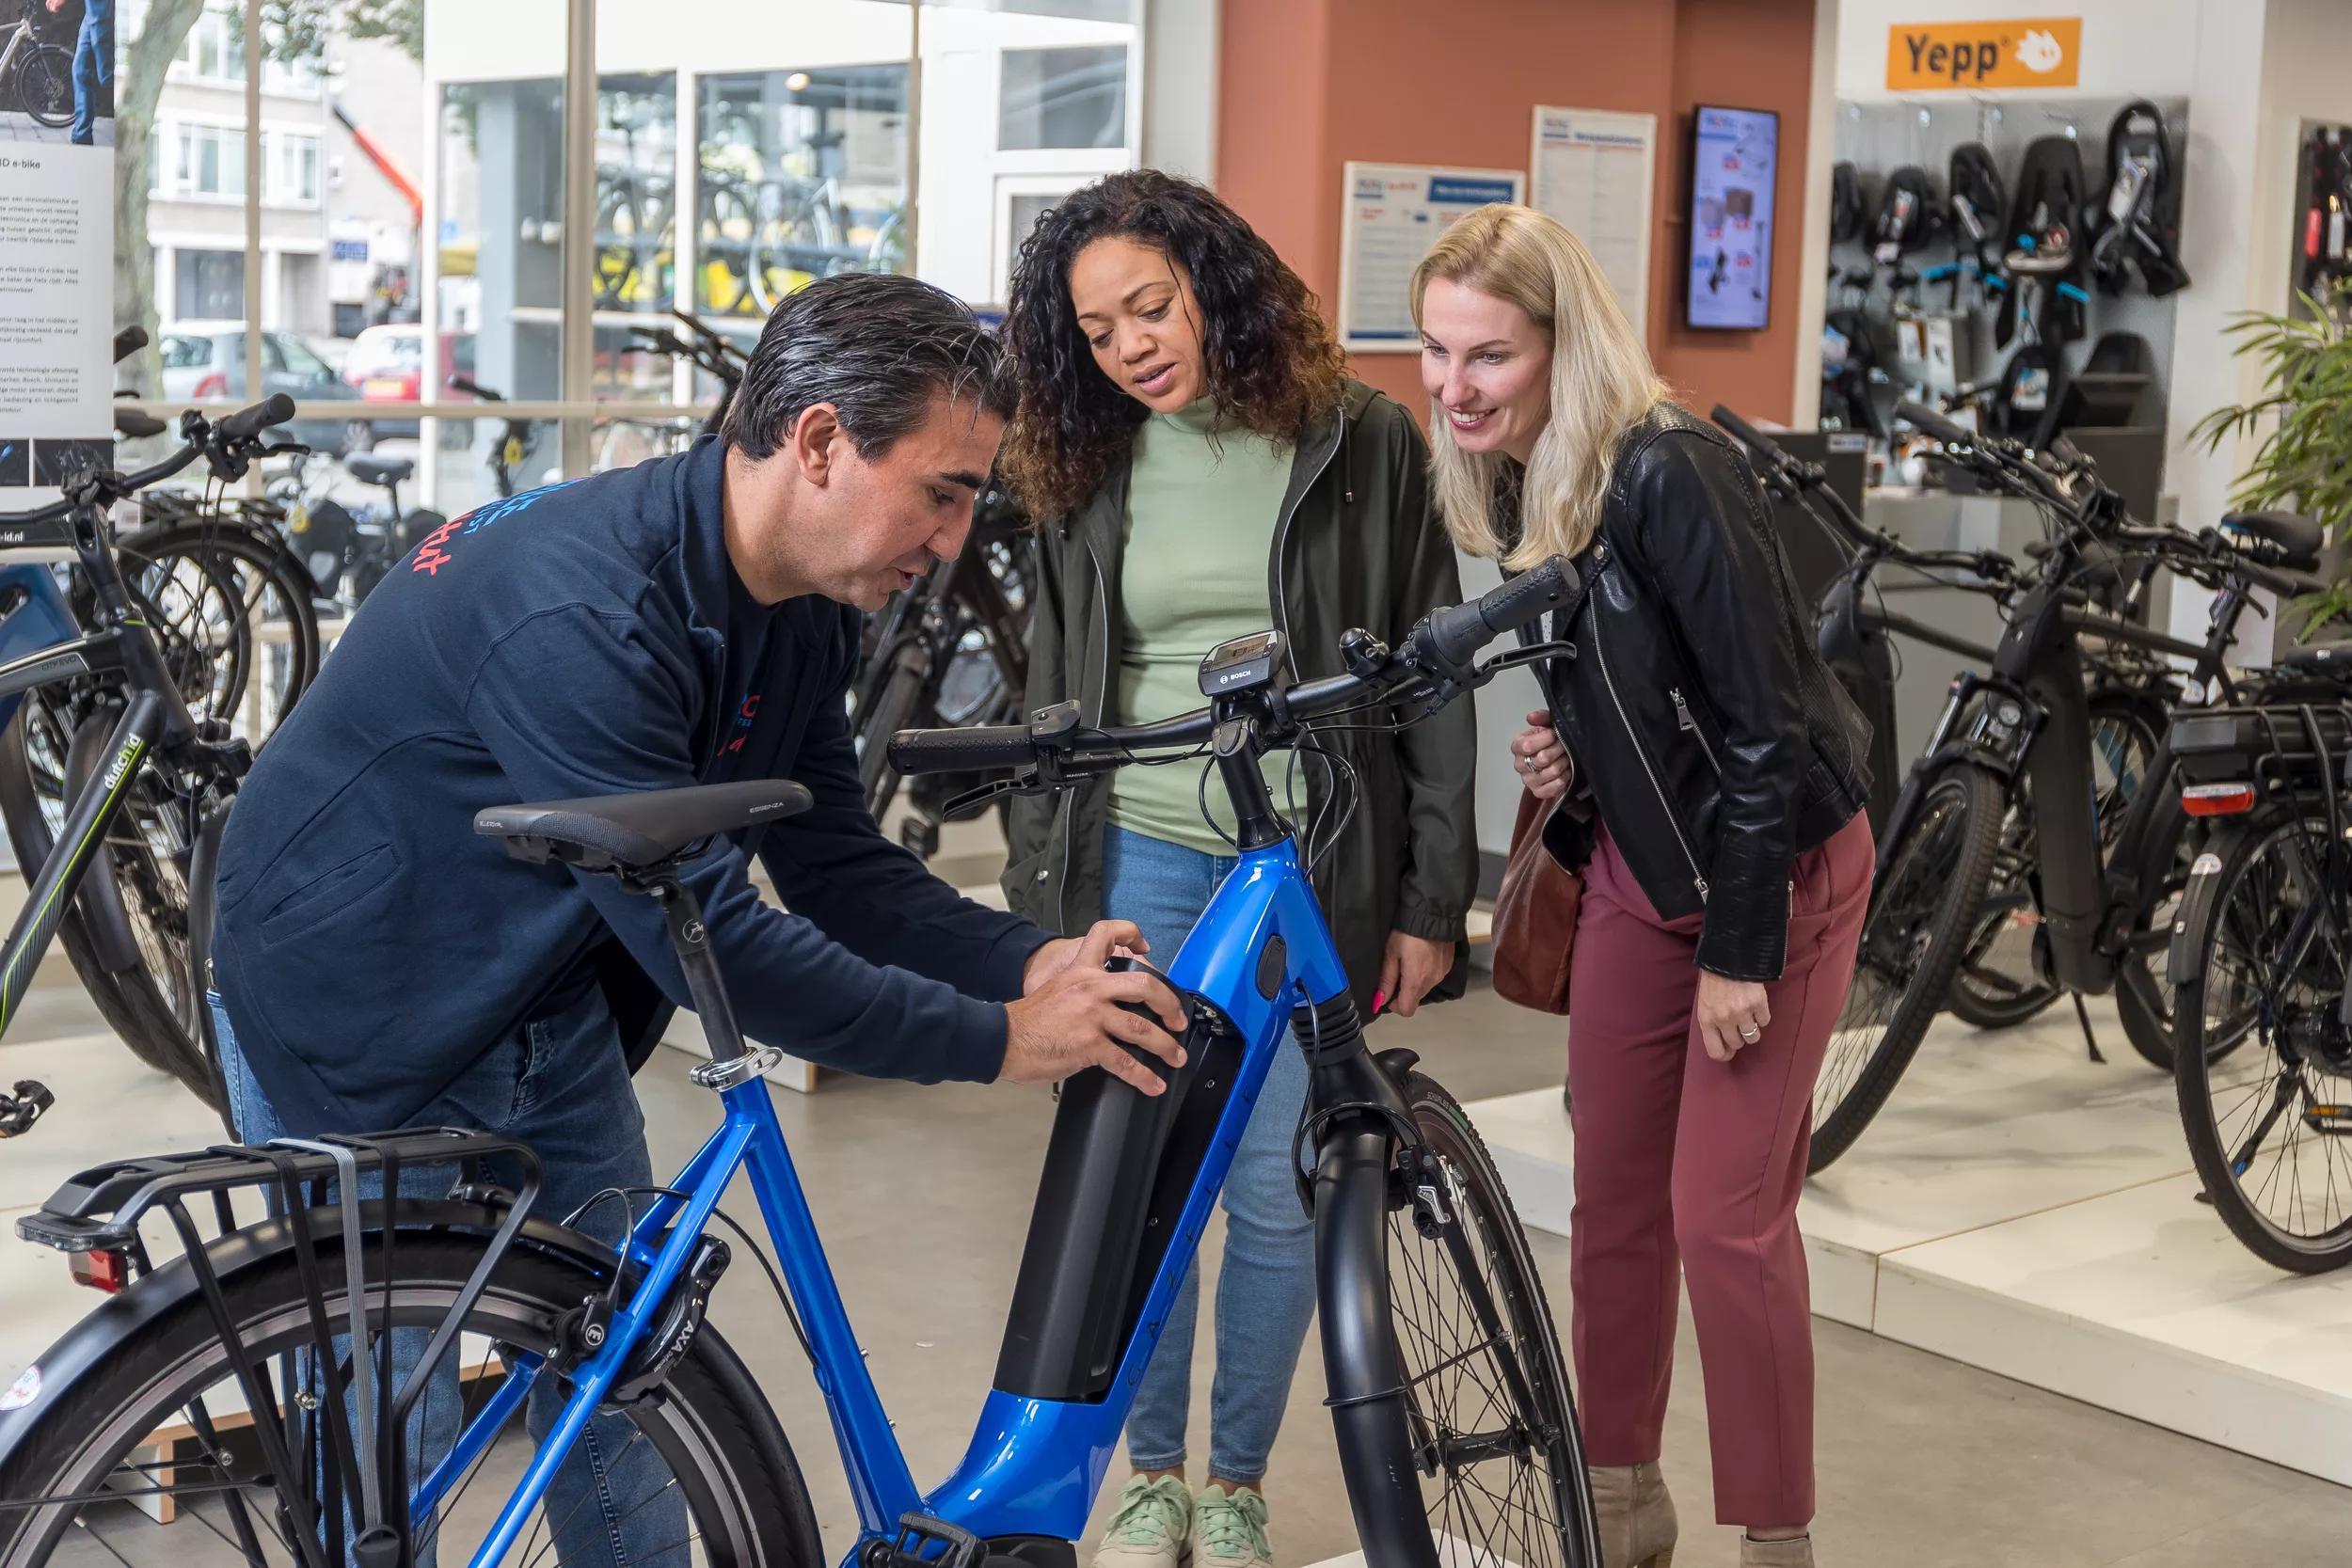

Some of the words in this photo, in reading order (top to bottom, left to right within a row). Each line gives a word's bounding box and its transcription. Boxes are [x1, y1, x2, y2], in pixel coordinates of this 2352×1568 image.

[1905, 33, 1997, 81] Yepp
[12, 158, 40, 169] e-bike
[1230, 670, 1251, 680] BOSCH
[671, 1319, 694, 1353] AXA
